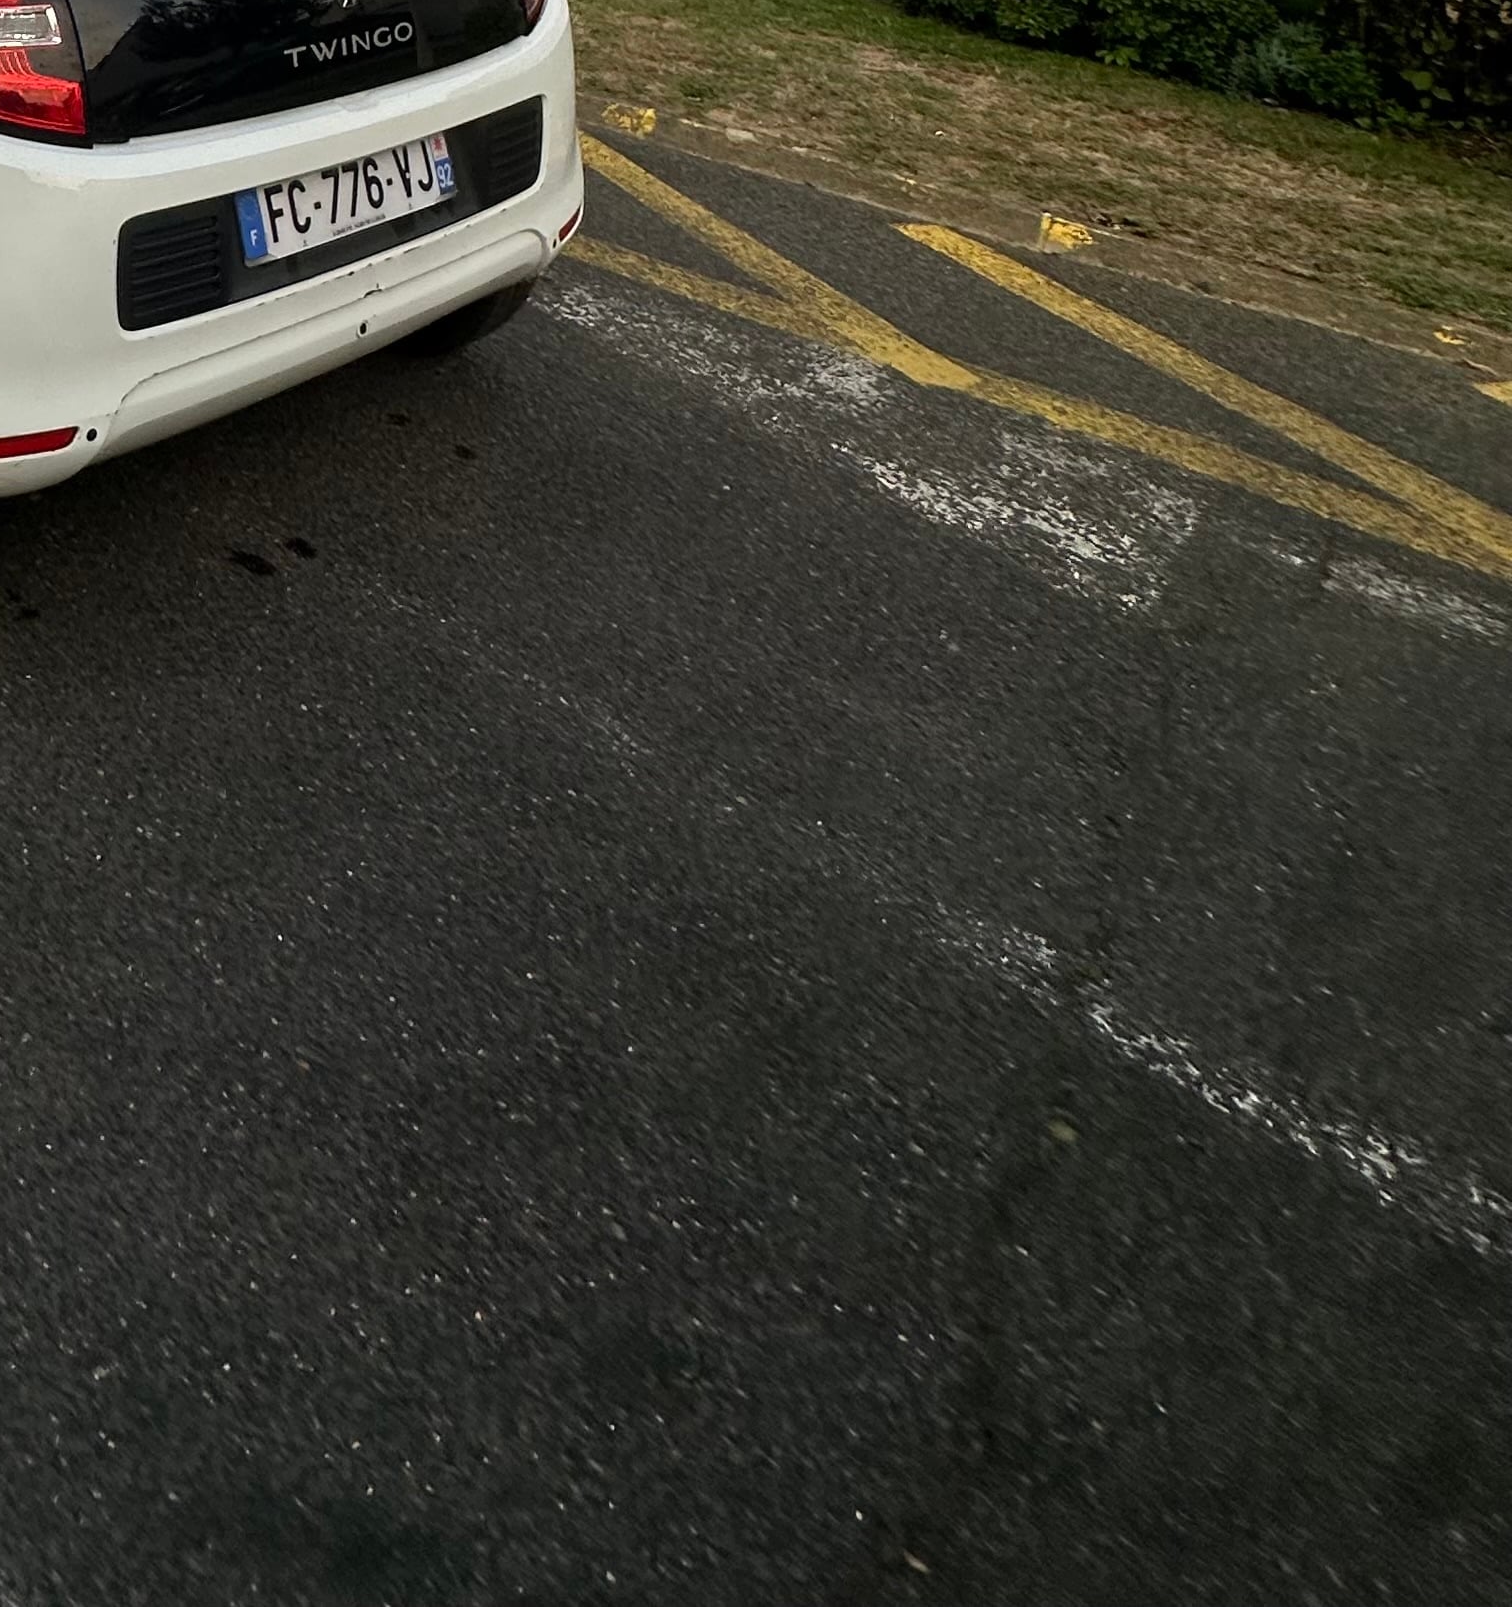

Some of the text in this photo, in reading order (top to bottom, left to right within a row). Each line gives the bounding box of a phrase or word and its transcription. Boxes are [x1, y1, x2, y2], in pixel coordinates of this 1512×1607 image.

[283, 21, 413, 68] TWINGO
[250, 228, 259, 247] F
[263, 140, 433, 243] FC-776-VJ
[437, 162, 455, 188] 92
